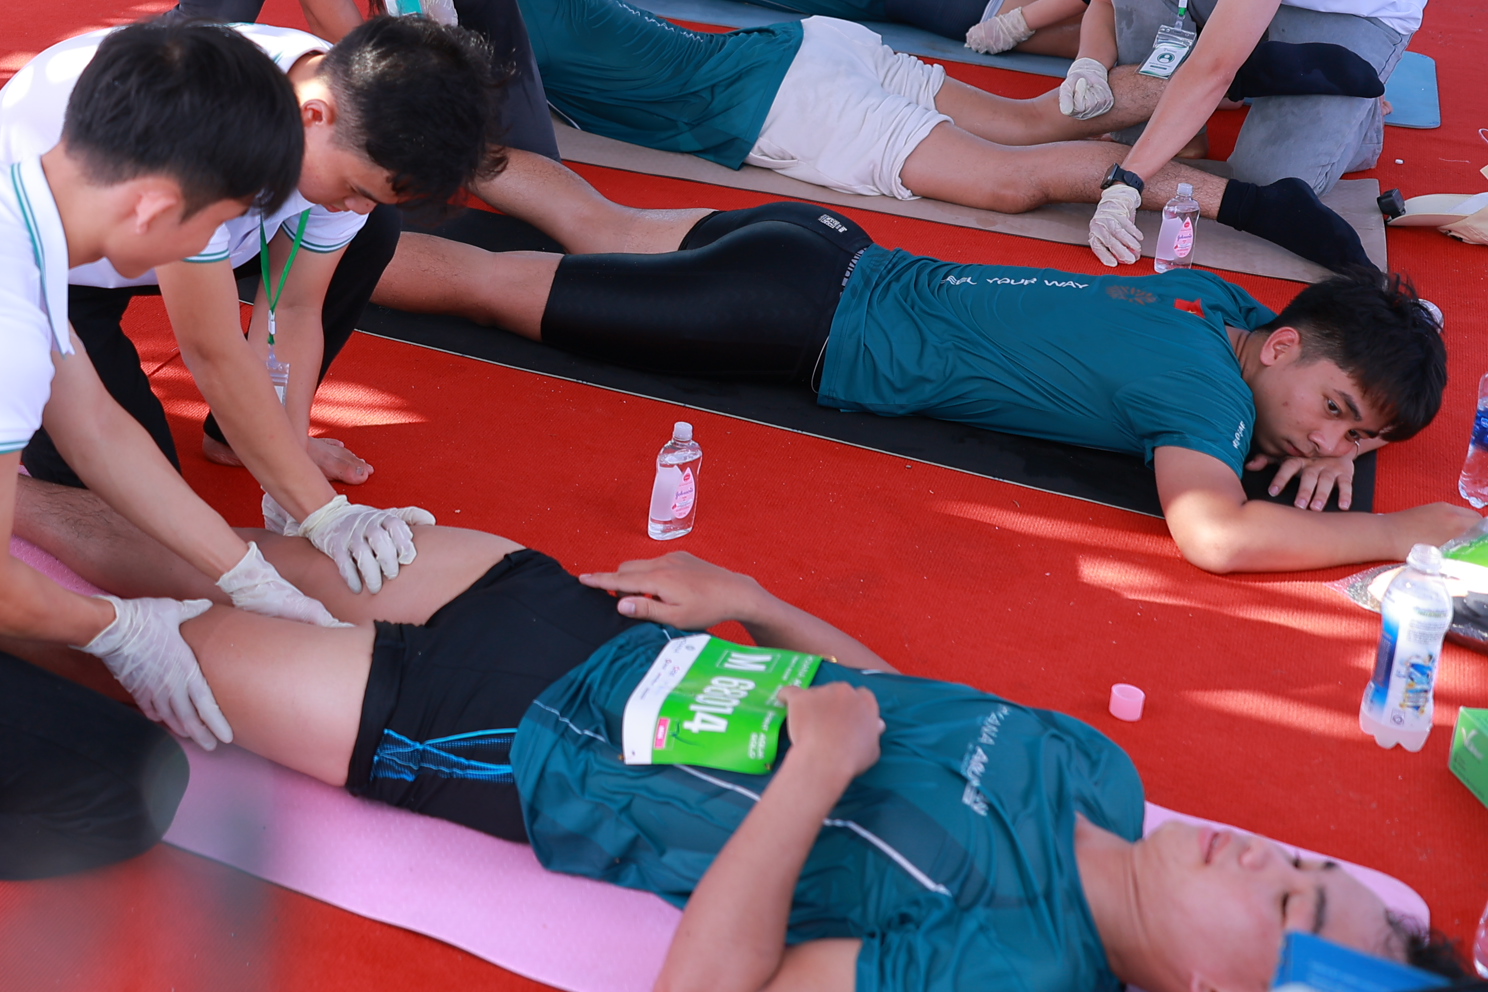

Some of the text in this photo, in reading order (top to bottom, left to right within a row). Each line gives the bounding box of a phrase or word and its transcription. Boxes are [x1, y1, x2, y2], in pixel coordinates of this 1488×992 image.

[986, 277, 1037, 286] YOUR
[1044, 279, 1089, 289] WAY
[683, 652, 772, 734] M 68014
